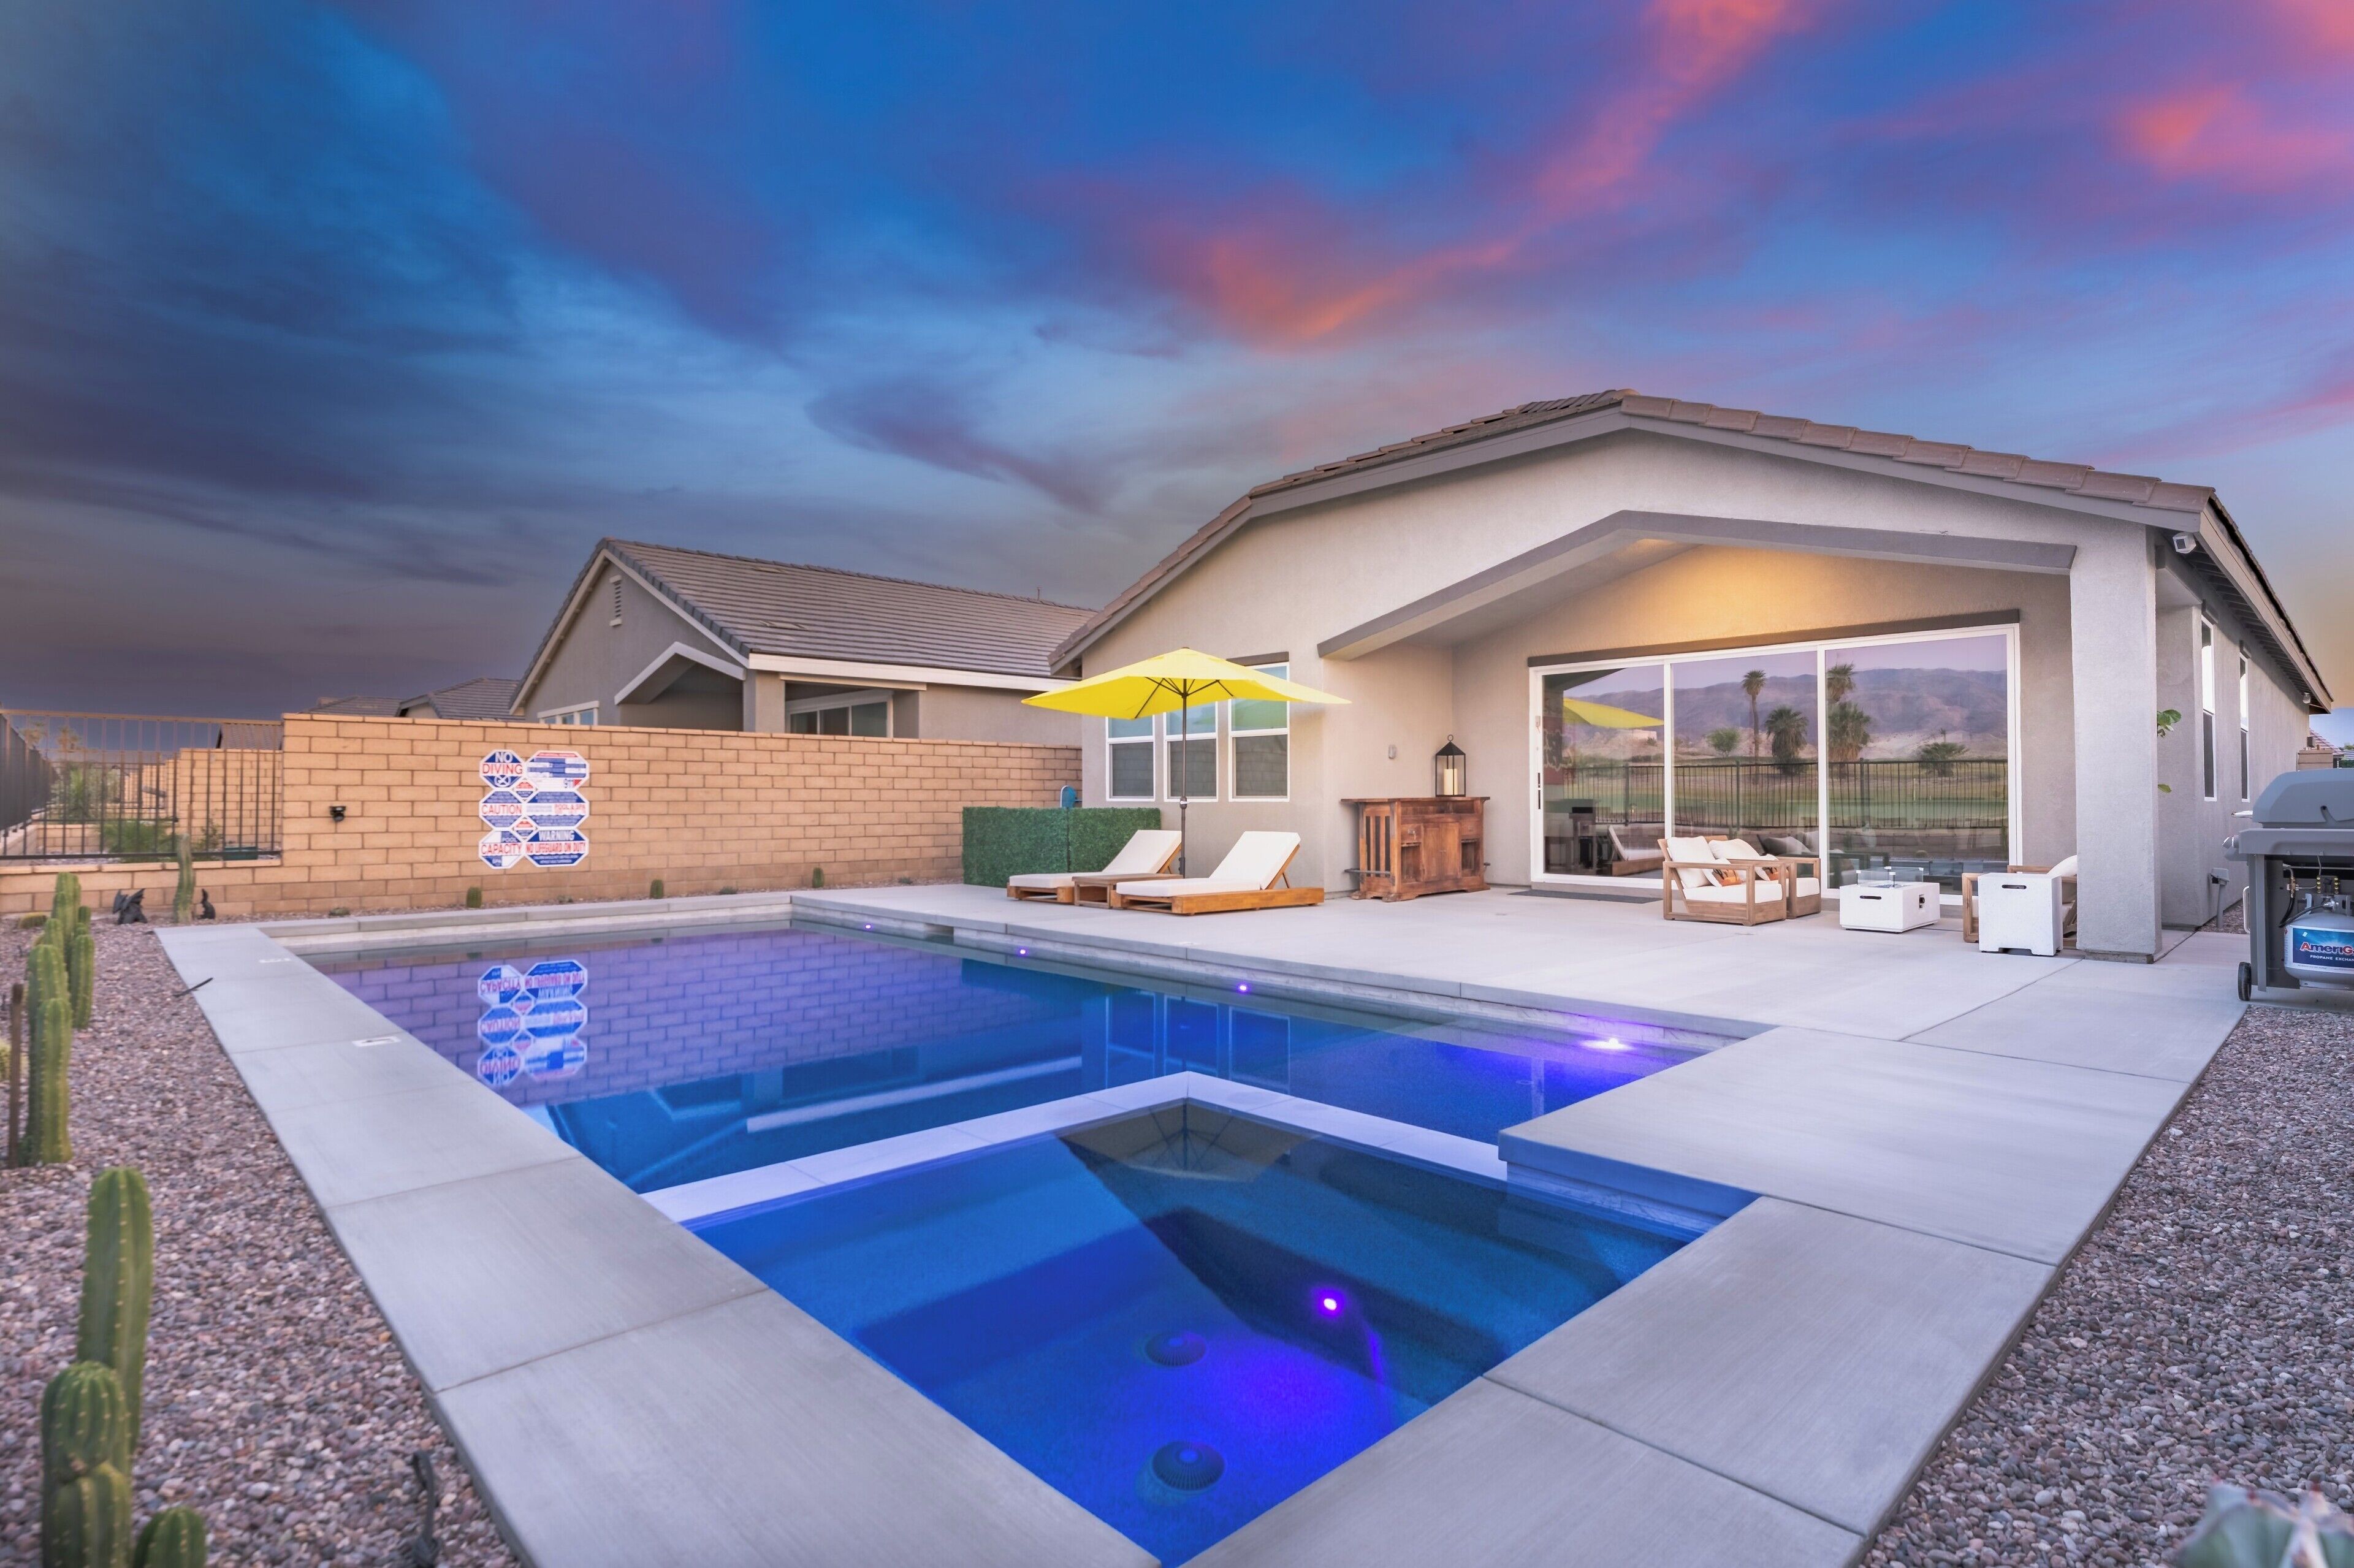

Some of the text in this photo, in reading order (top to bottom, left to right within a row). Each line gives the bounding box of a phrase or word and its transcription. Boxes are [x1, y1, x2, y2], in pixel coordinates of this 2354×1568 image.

[495, 752, 513, 763] NO
[482, 763, 523, 774] DIVING
[482, 804, 522, 814] CAUTION
[539, 831, 575, 841] WARNING
[481, 843, 522, 854] CAPACITY
[2299, 941, 2354, 955] AmeriG
